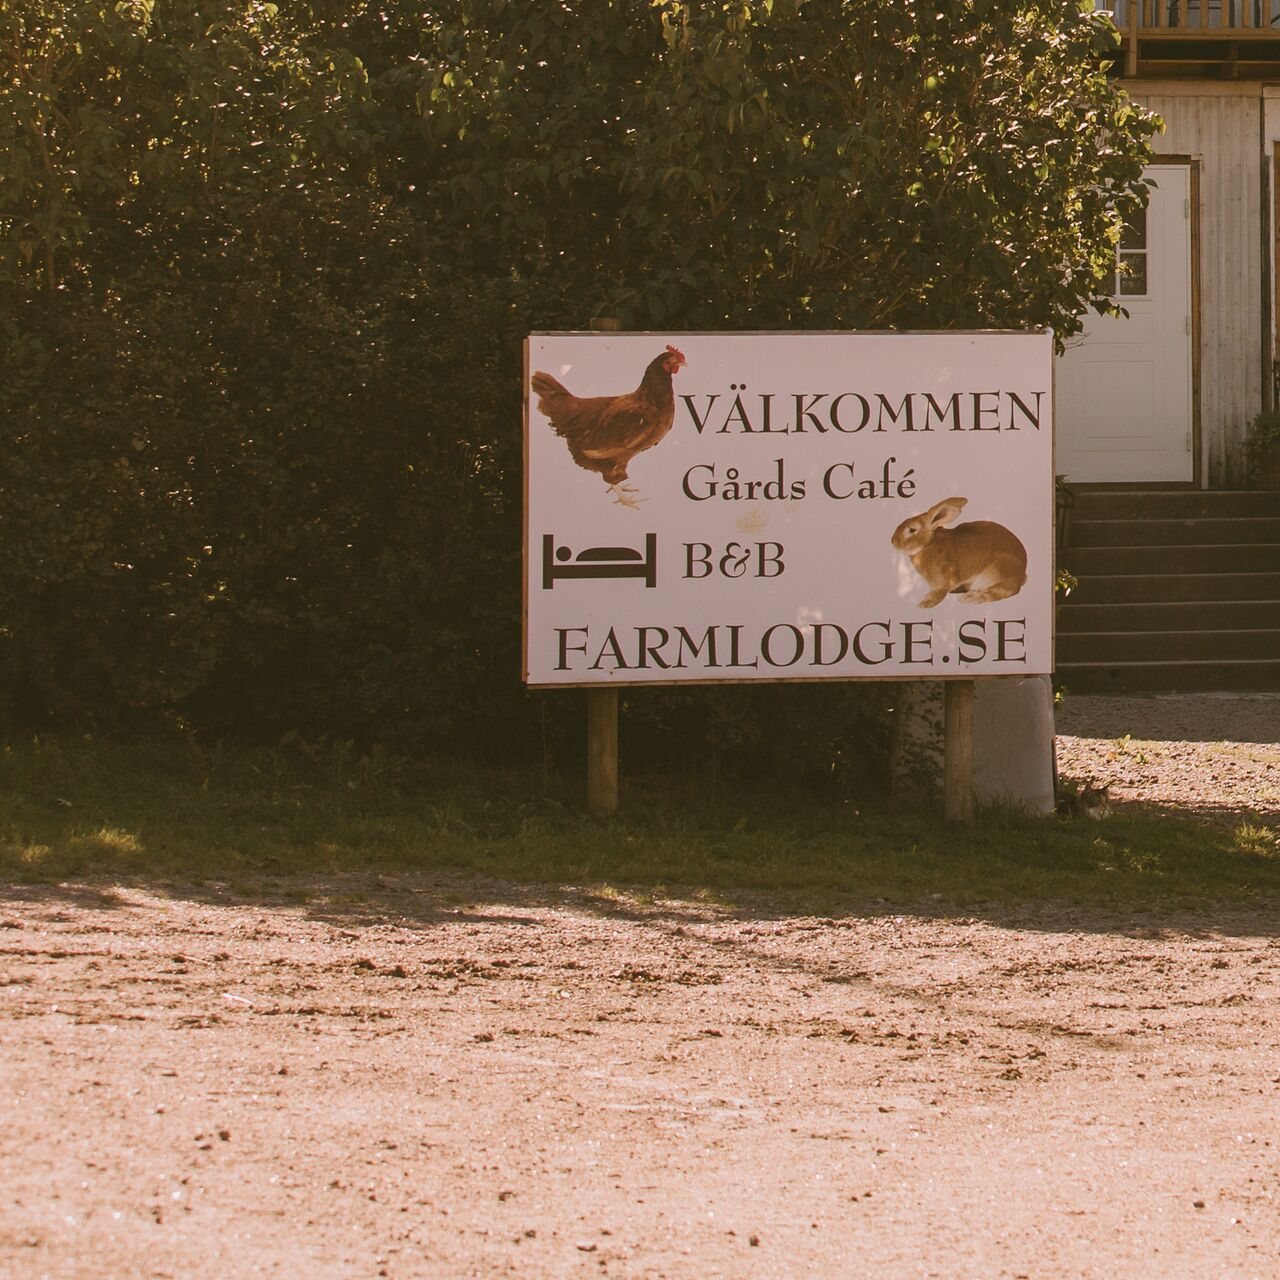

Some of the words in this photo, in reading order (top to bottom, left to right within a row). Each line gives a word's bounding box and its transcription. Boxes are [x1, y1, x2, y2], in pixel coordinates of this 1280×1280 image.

[679, 384, 1046, 435] VÄLKOMMEN
[682, 458, 806, 501] Gårds
[823, 457, 916, 500] Café
[682, 542, 785, 579] B&B
[553, 617, 1028, 671] FARMLODGE.SE
